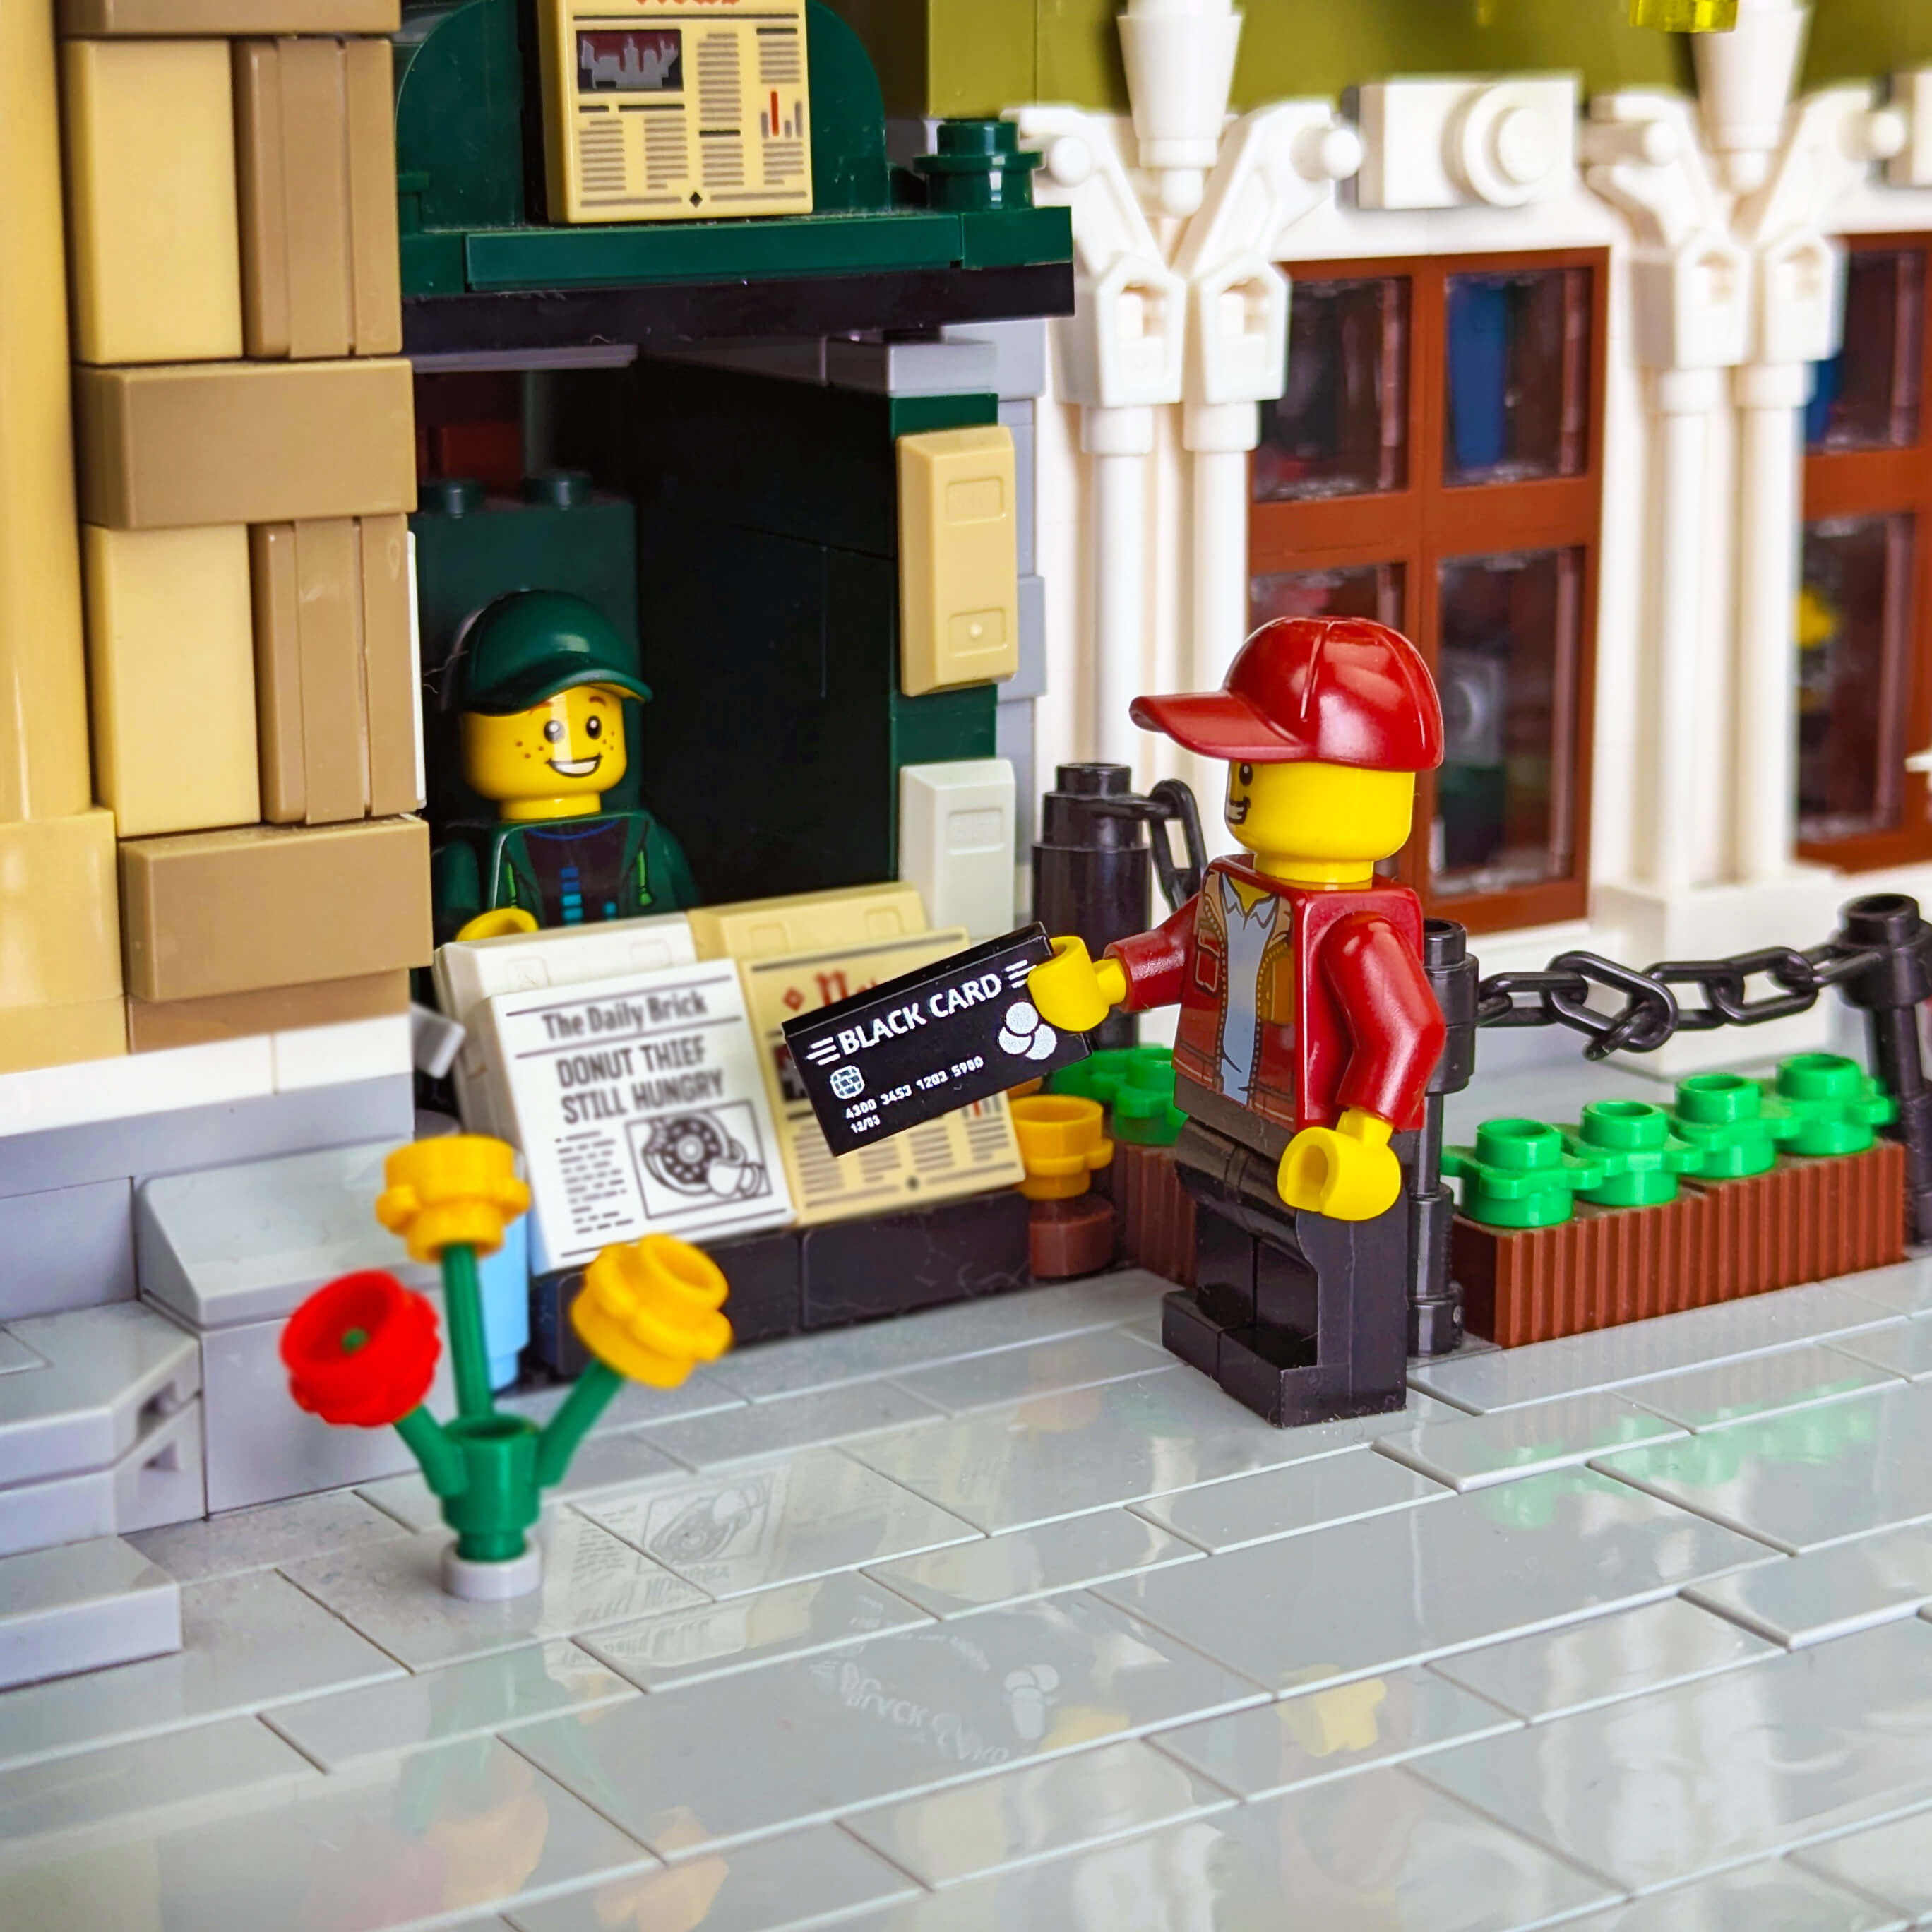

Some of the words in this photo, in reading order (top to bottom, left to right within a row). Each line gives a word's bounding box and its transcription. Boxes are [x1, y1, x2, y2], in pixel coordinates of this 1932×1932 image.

[542, 1012, 584, 1039] The
[586, 1000, 643, 1032] Daily
[646, 990, 708, 1022] Brick
[837, 1002, 927, 1055] BLACK
[929, 973, 1002, 1018] CARD
[556, 1046, 634, 1088] DONUT
[639, 1034, 705, 1072] THIEF
[561, 1087, 628, 1124] STILL
[631, 1067, 724, 1110] HUNGRY
[845, 1098, 877, 1119] 4300
[880, 1084, 912, 1106] 3453
[916, 1070, 949, 1090] 1203
